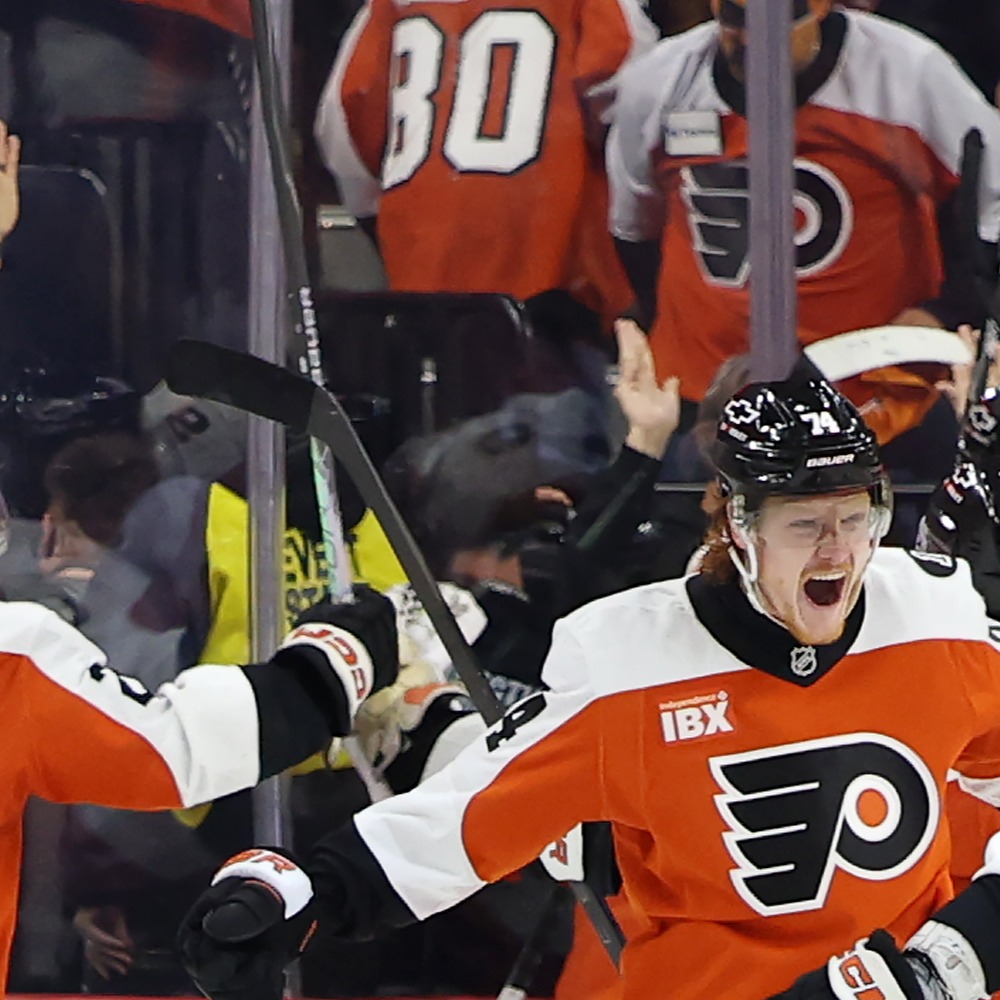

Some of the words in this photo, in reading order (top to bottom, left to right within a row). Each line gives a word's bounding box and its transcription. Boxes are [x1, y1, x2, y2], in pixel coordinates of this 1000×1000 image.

[800, 411, 840, 436] 74
[806, 453, 855, 468] BAUER
[660, 700, 735, 743] IBX
